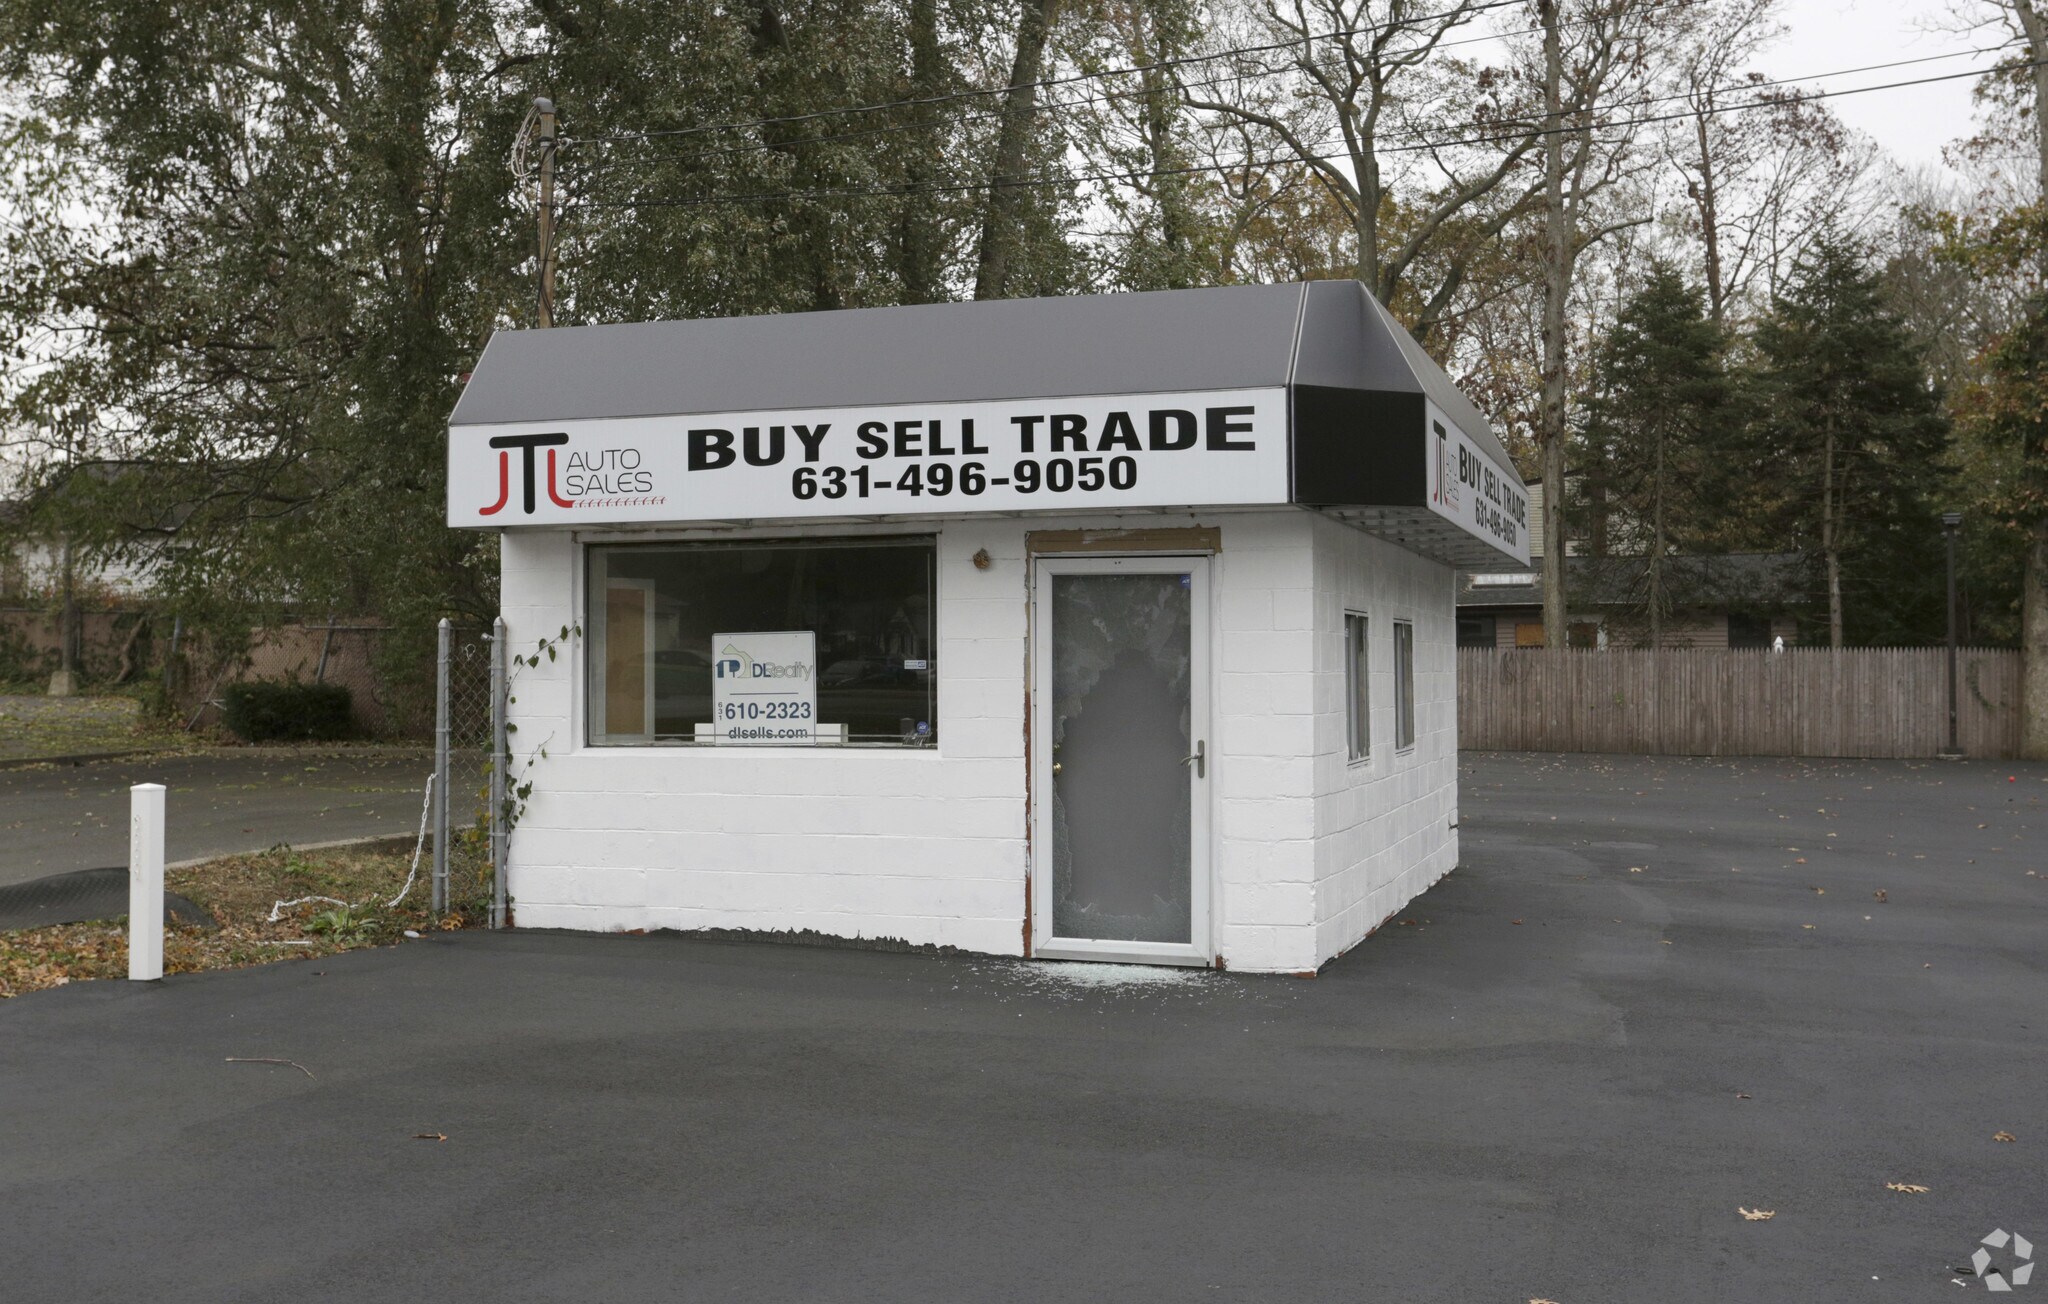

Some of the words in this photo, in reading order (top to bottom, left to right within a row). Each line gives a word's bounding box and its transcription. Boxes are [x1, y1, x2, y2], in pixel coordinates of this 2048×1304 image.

[688, 424, 832, 471] BUY
[856, 418, 989, 459] SELL
[1010, 405, 1256, 453] TRADE
[566, 448, 641, 472] AUTO
[566, 472, 653, 496] SALES
[792, 455, 1138, 500] 631-496-9050
[1459, 443, 1482, 492] BUY
[1484, 467, 1501, 506] SELL
[1502, 482, 1526, 530] TRADE
[1475, 497, 1517, 547] 631-496-9050
[725, 702, 811, 719] 610-2323
[728, 727, 808, 739] dlsells.com
